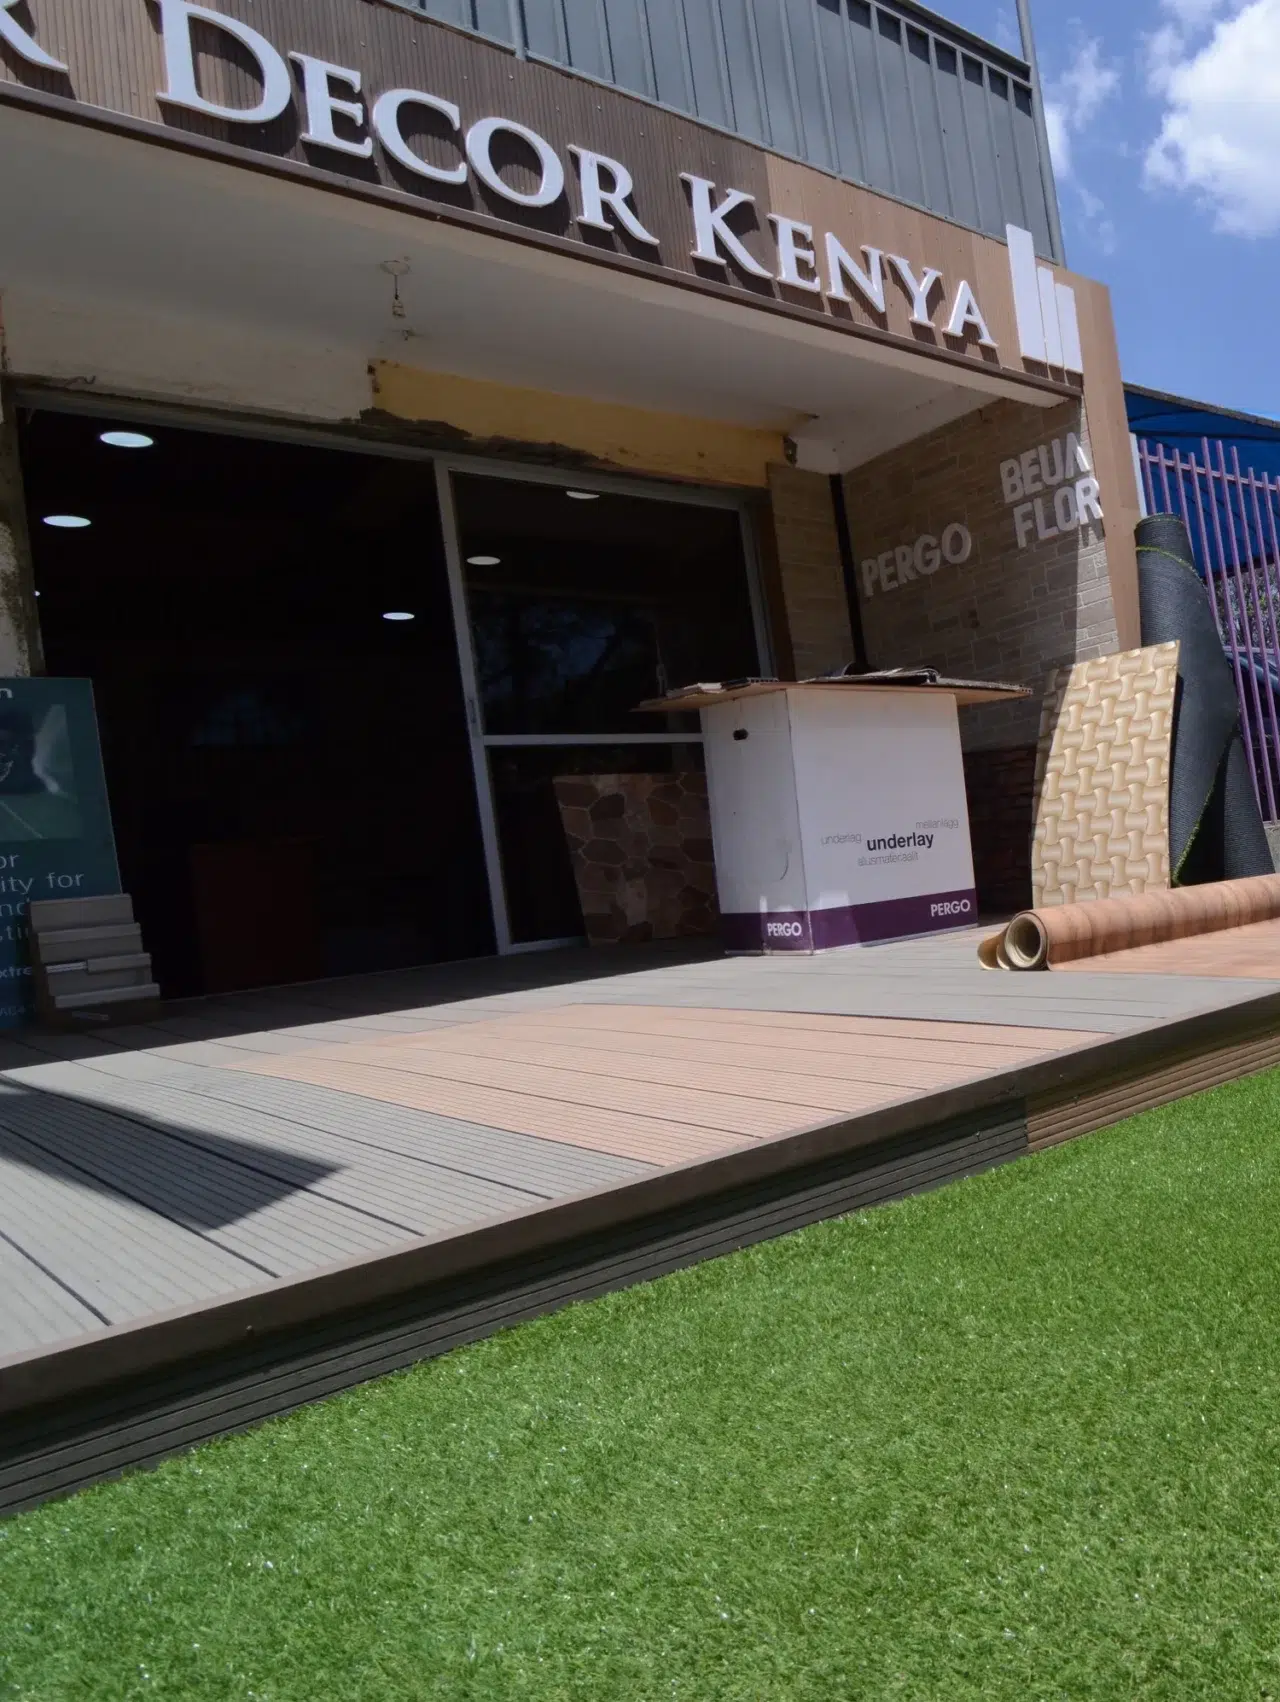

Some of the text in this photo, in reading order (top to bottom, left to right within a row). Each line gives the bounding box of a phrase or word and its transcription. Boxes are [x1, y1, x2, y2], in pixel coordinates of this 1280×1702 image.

[156, 0, 999, 349] DECOR KENYA
[1013, 477, 1104, 549] FLOR
[861, 522, 972, 597] PERGO
[866, 832, 934, 851] underlay
[46, 871, 85, 888] for
[929, 899, 971, 917] PERGO
[767, 922, 802, 936] PERGO
